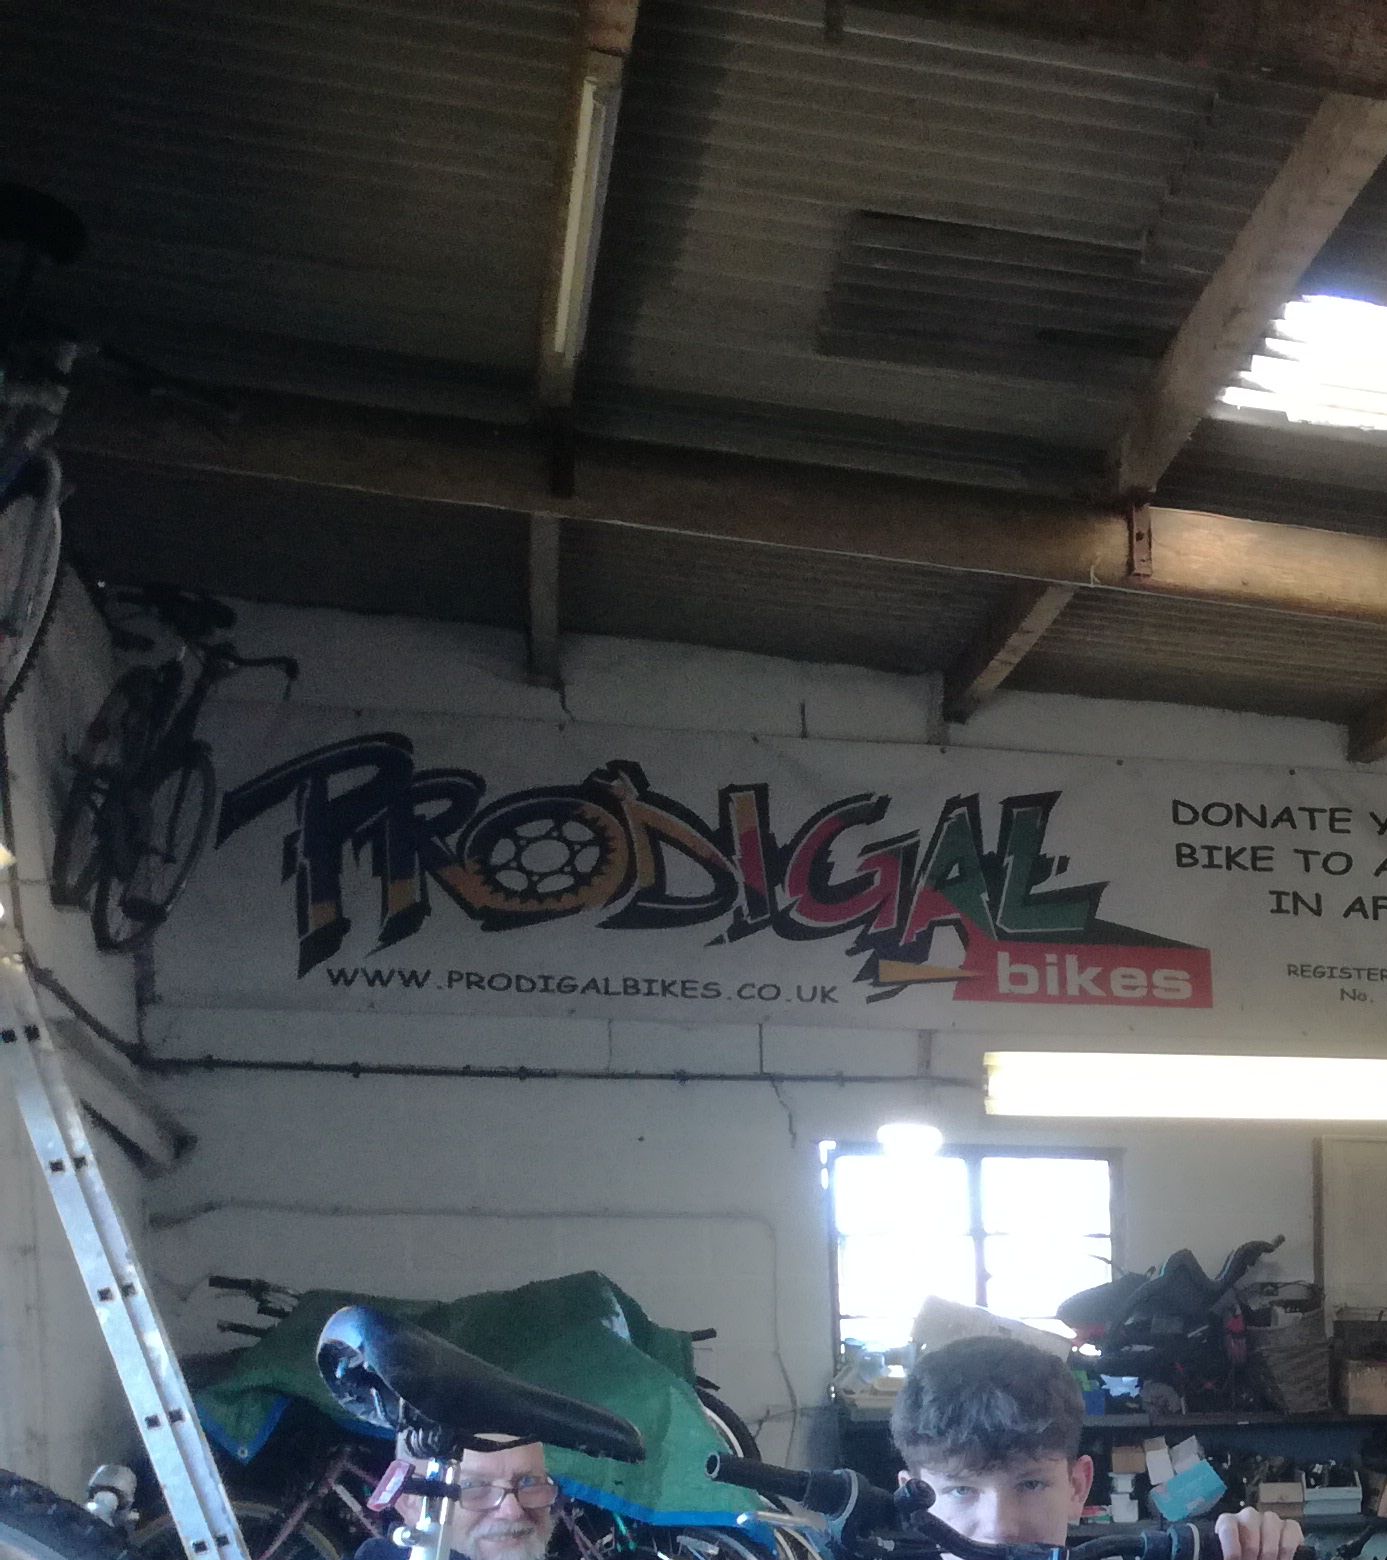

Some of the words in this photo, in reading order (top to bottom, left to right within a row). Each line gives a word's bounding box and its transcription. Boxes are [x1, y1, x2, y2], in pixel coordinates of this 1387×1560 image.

[1171, 798, 1353, 835] DONATE
[1175, 842, 1275, 873] BIKE
[1293, 848, 1354, 876] TO
[1268, 889, 1323, 918] IN
[325, 966, 839, 1004] WWW.PRODIGALBIKES.CO.UK
[997, 950, 1193, 1000] bikes
